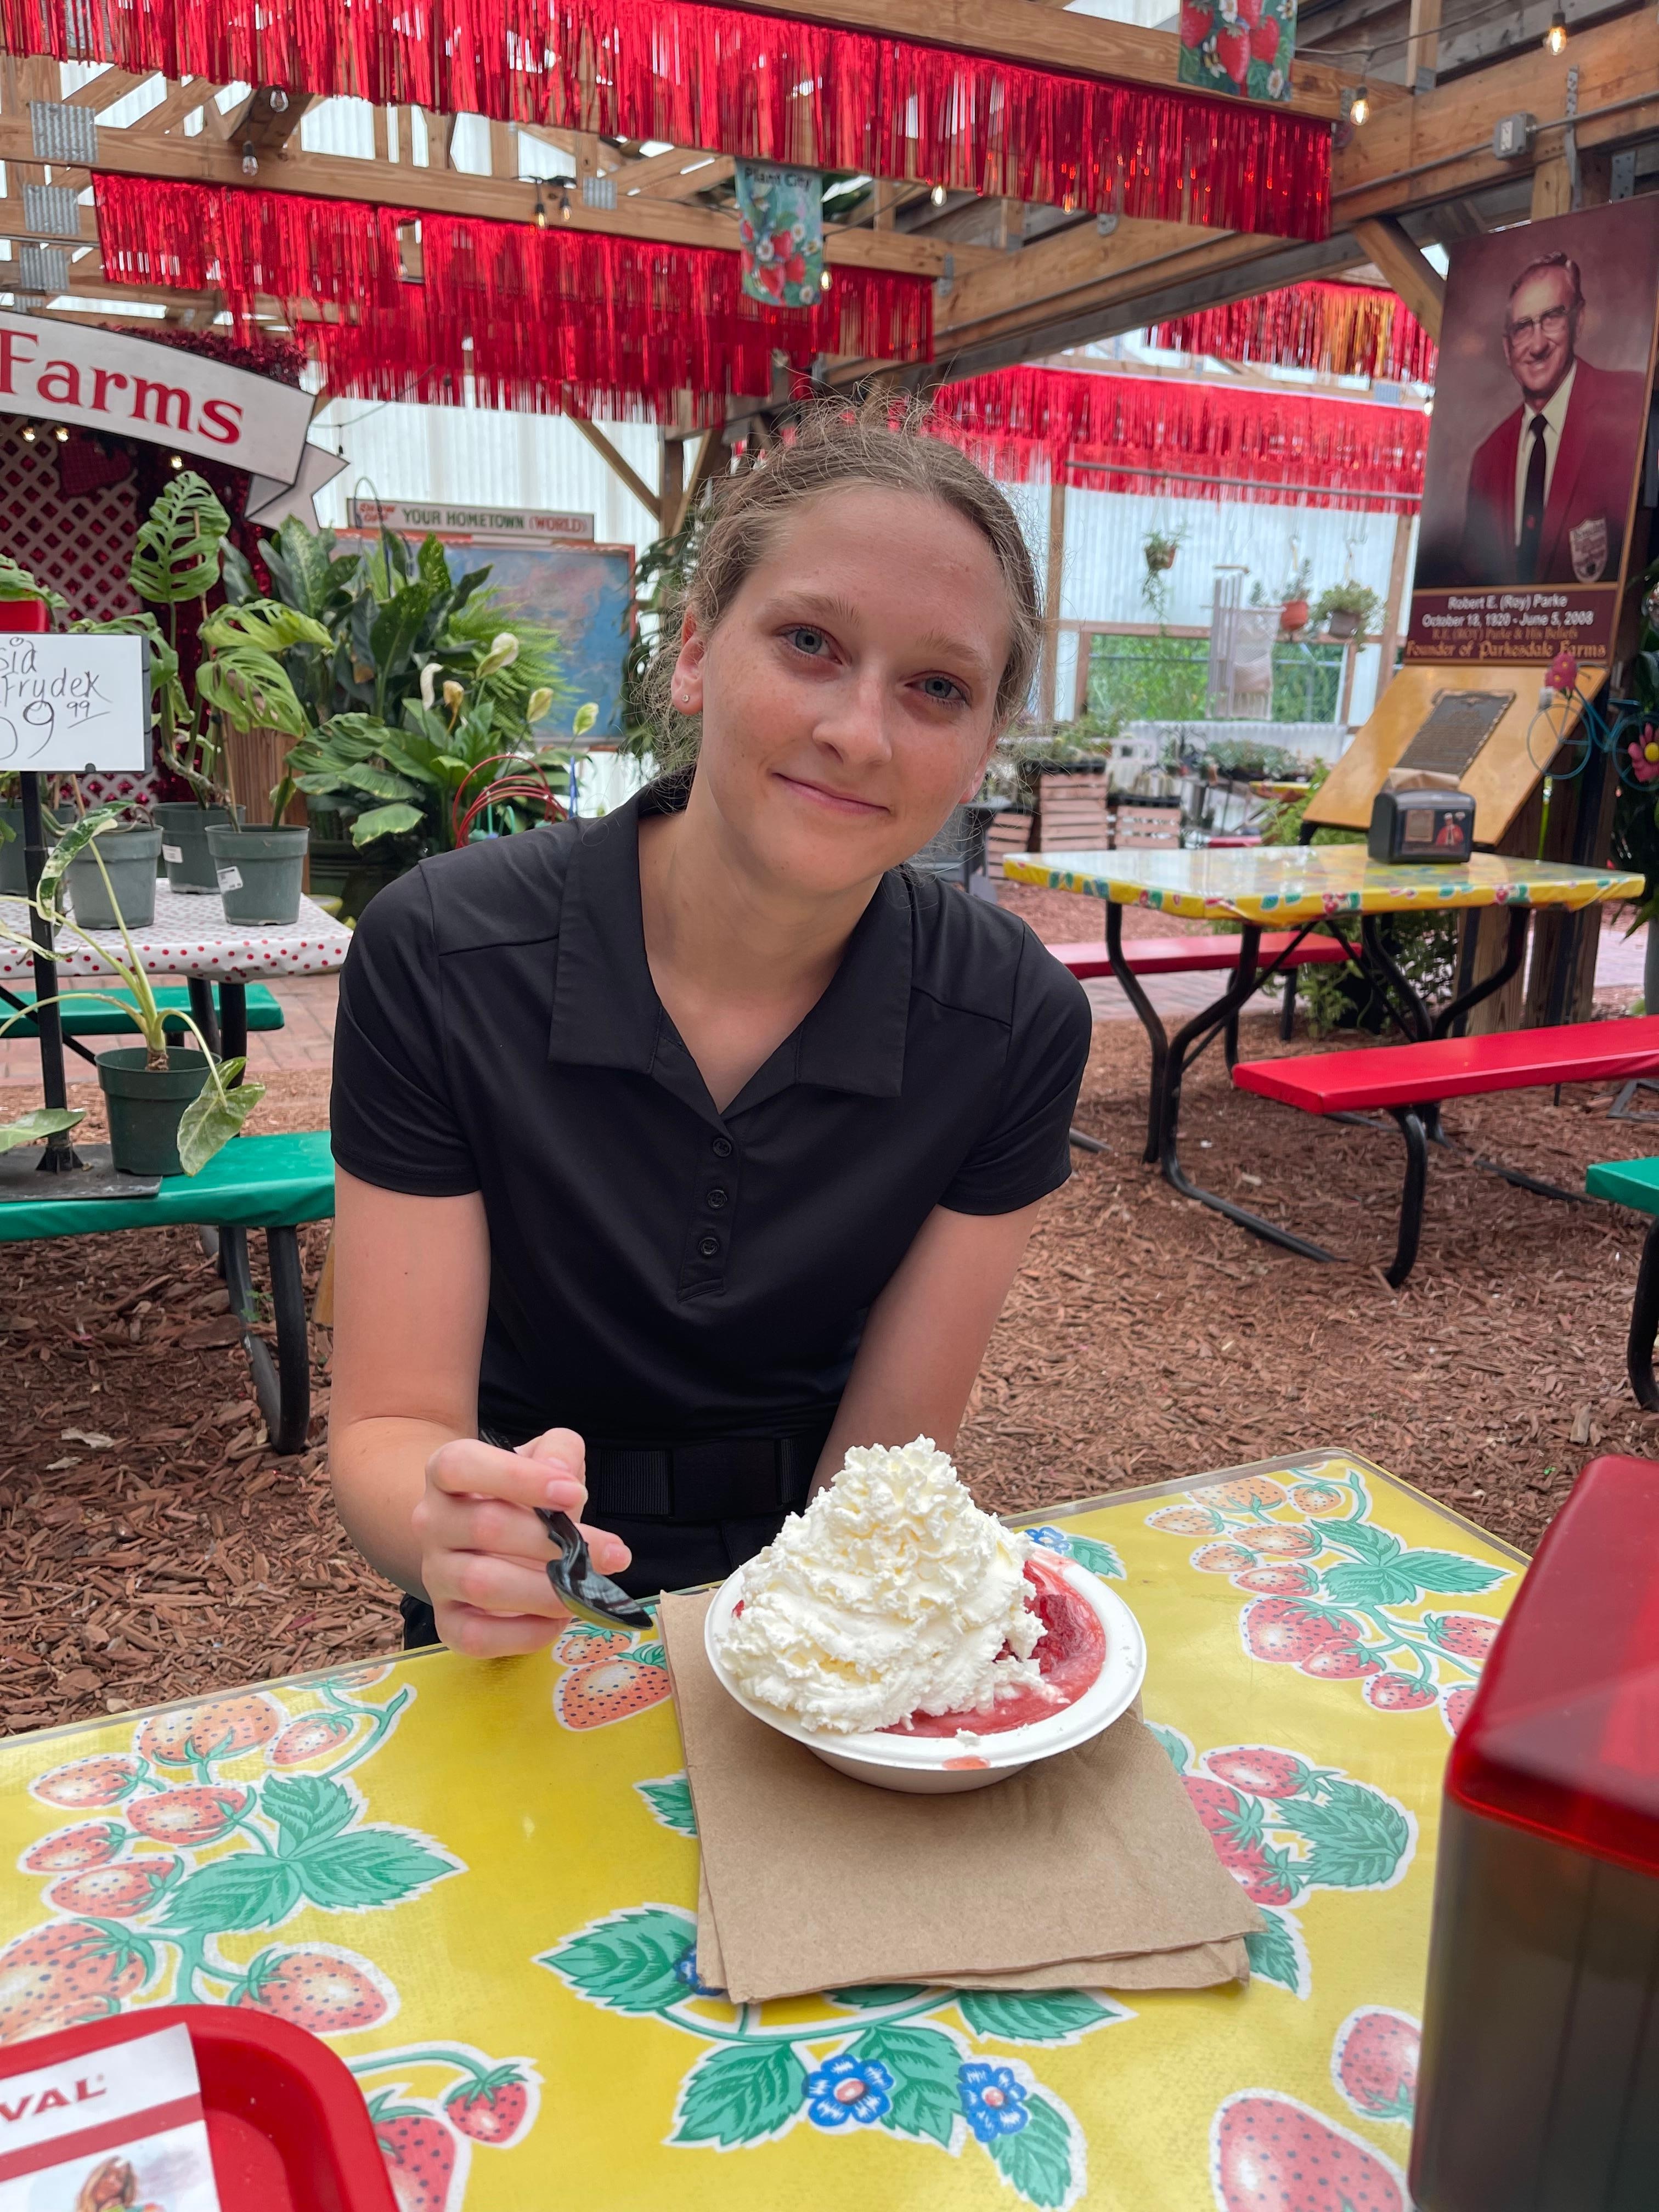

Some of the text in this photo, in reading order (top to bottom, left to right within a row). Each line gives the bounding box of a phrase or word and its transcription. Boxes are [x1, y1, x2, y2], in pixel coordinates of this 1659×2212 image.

[0, 329, 243, 444] Farms
[403, 508, 587, 533] YOUR HOMETOWN (WORLD)
[1447, 592, 1568, 612] Robert E. (Roy) Parke
[1421, 613, 1465, 628] October
[1519, 611, 1549, 627] June
[1407, 639, 1456, 657] Founder
[1458, 639, 1474, 657] of
[1559, 639, 1607, 658] Farms
